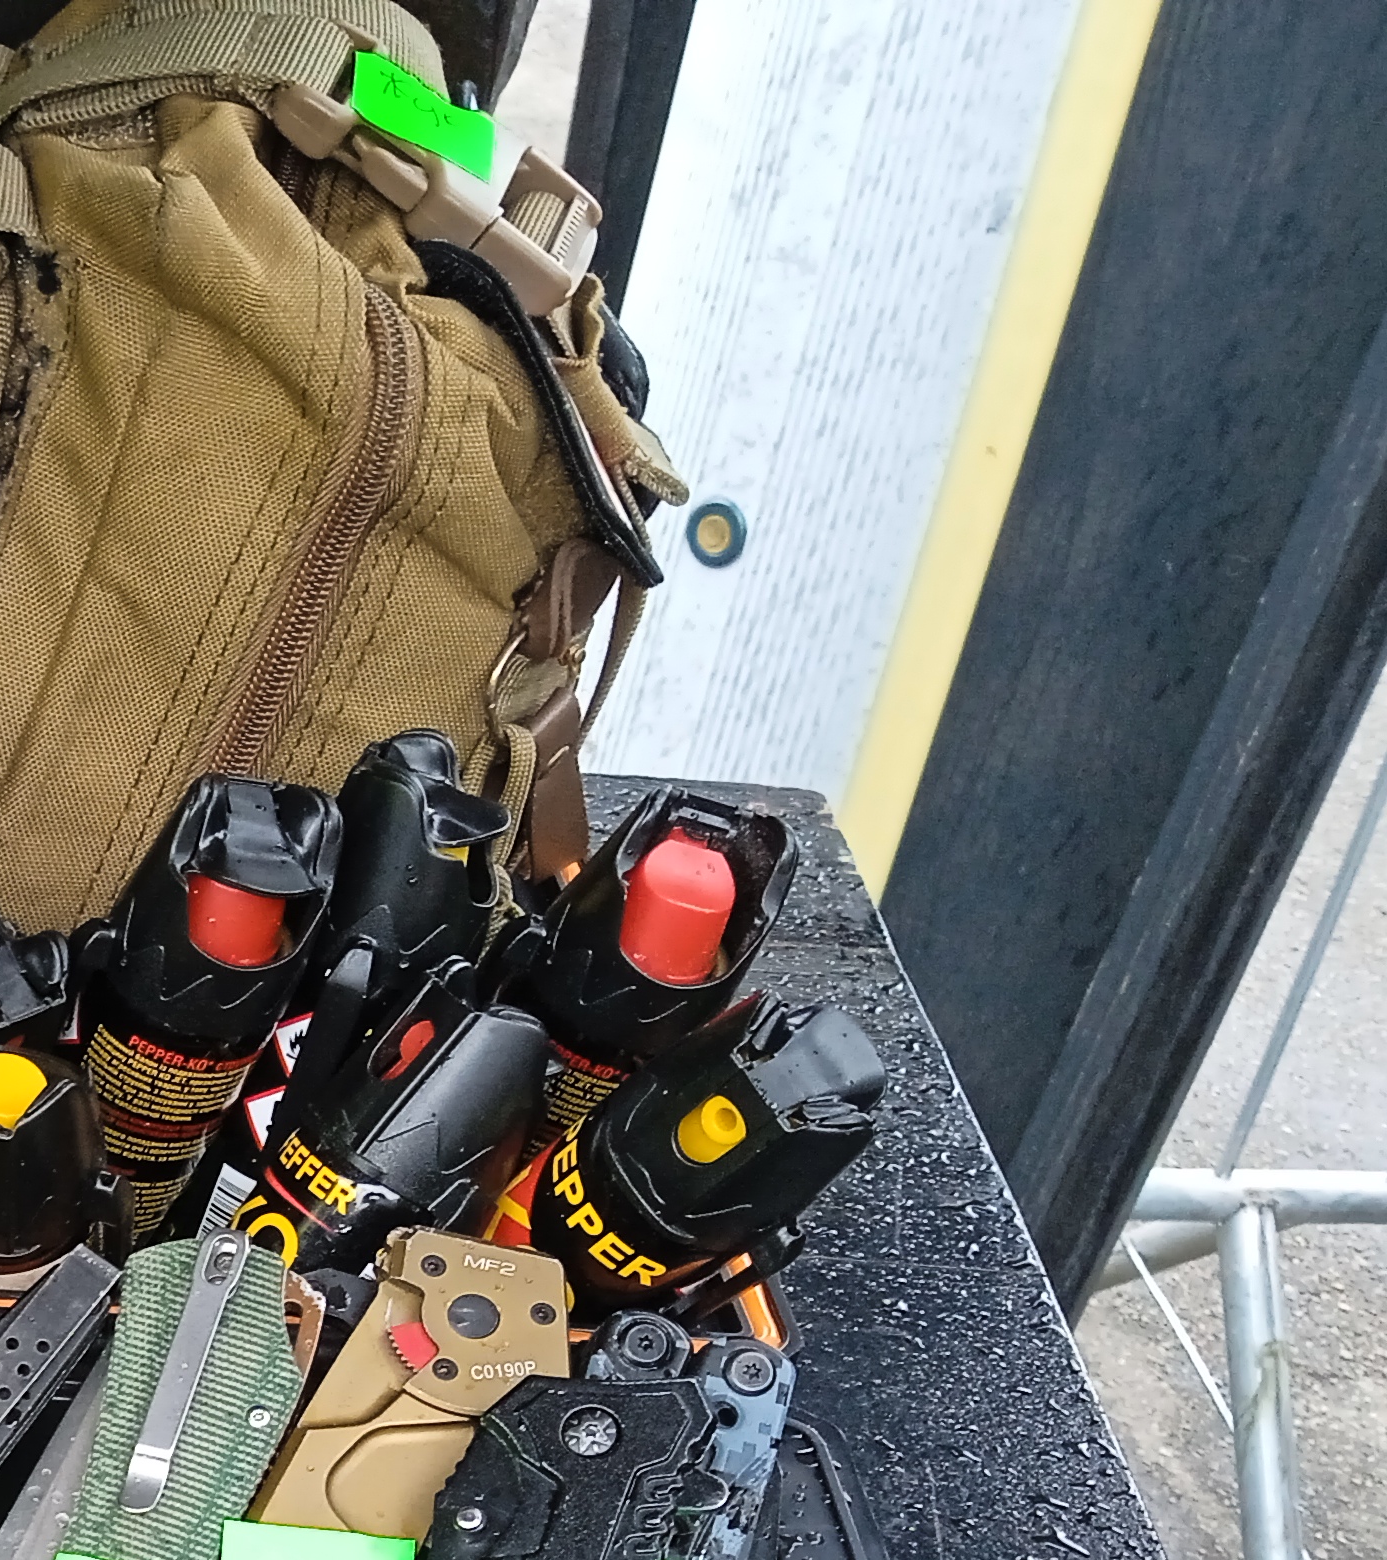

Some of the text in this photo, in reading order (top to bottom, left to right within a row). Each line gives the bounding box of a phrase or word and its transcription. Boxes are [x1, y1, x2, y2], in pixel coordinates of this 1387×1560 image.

[279, 1127, 357, 1215] EFFER
[551, 1113, 667, 1288] PEPPER
[463, 1253, 517, 1278] MF2
[470, 1358, 539, 1382] C0190P
